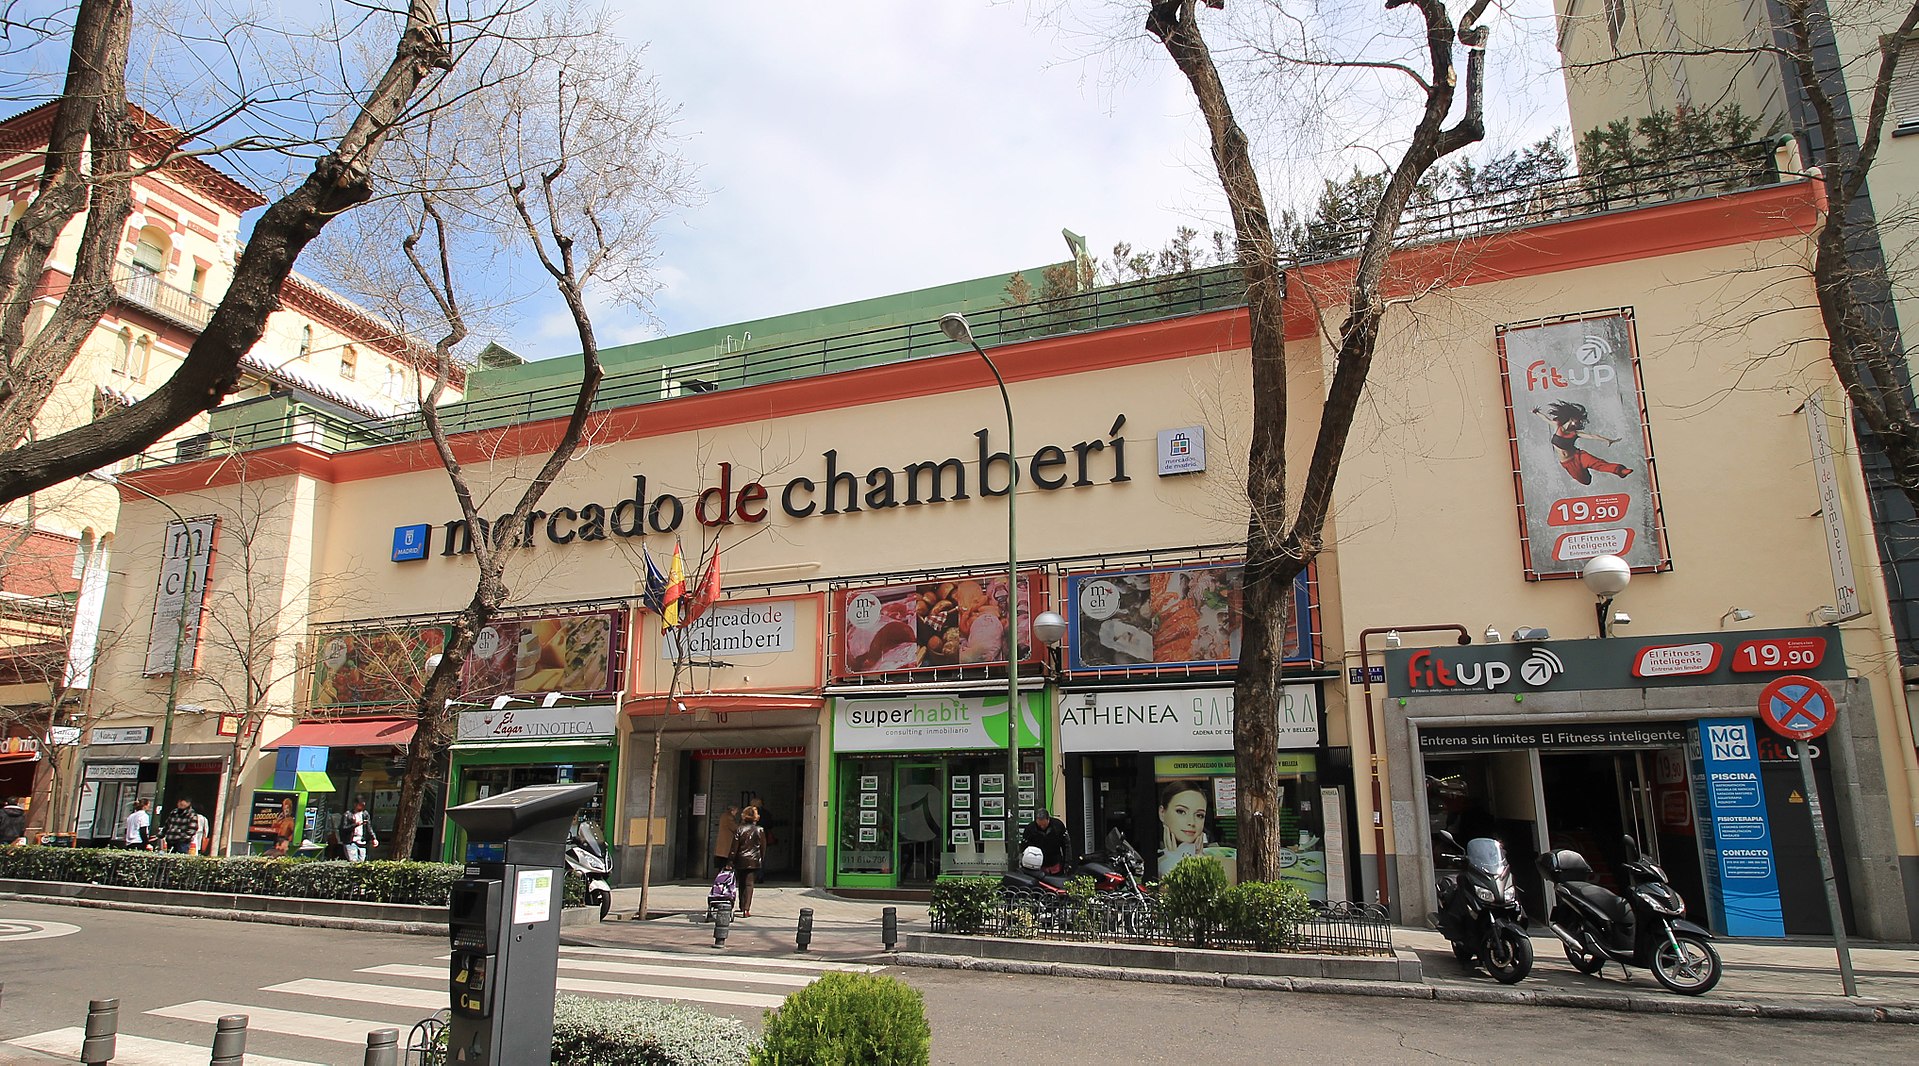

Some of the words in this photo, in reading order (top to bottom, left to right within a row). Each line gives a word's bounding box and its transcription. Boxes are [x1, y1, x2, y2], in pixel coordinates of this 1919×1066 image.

[1821, 470, 1830, 483] de
[440, 474, 684, 556] mercado
[695, 461, 769, 528] de
[781, 413, 1132, 519] chamberí
[1557, 501, 1619, 521] 19,90
[1581, 534, 1617, 542] Fitness
[398, 547, 419, 555] MADRID
[1568, 541, 1617, 550] inteligente
[1090, 586, 1105, 596] m
[856, 598, 869, 607] m
[1090, 595, 1105, 607] ch
[855, 606, 869, 618] ch
[689, 626, 782, 652] chamberí
[1663, 649, 1702, 658] Fitness
[1743, 644, 1815, 667] 19,90
[1650, 656, 1702, 666] inteligente
[502, 712, 515, 725] El
[852, 701, 971, 727] superhabit
[1061, 704, 1179, 727] ATHENEA
[493, 723, 523, 737] Lagar
[527, 720, 595, 736] VINOTECA
[886, 728, 922, 737] consulting
[926, 727, 969, 735] inmobiliario
[1711, 727, 1744, 743] Ma
[1420, 735, 1467, 745] Entrena
[1471, 734, 1490, 744] sin
[1493, 733, 1536, 744] límites
[1542, 733, 1554, 744] El
[1558, 732, 1606, 743] Fitness
[1609, 730, 1685, 745] inteligente.
[700, 747, 752, 757] CALIDAD
[766, 745, 804, 755] SALUD
[1715, 741, 1746, 758] Ná
